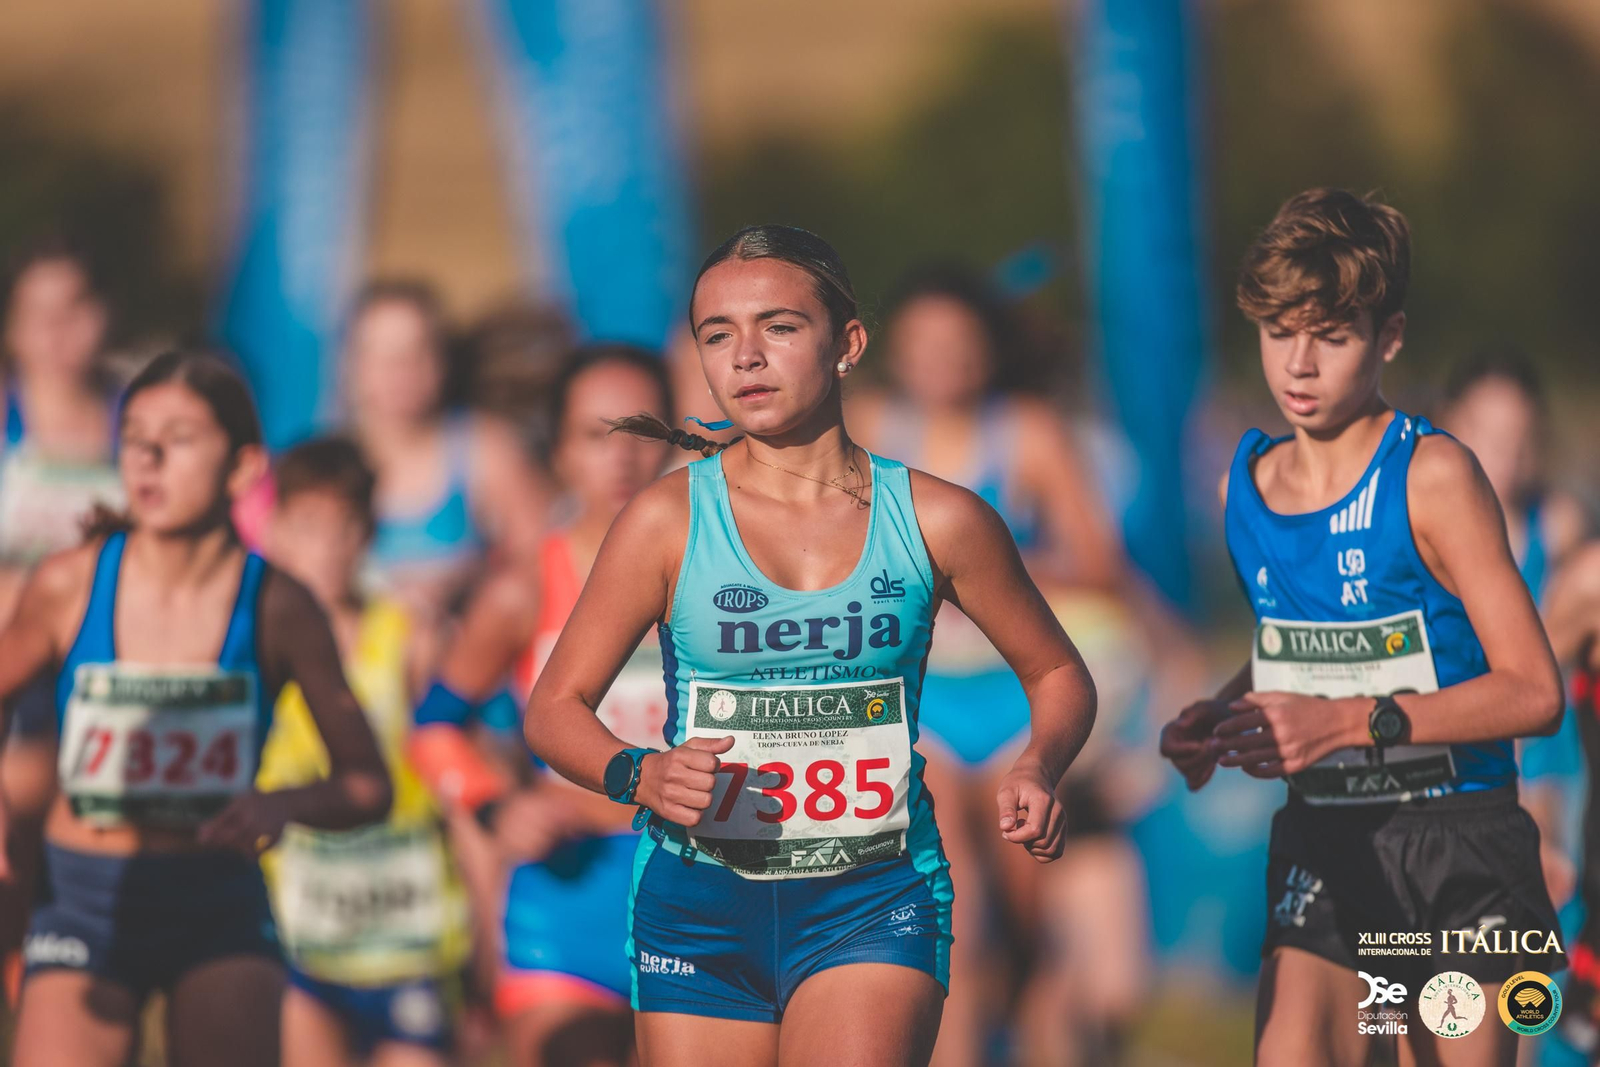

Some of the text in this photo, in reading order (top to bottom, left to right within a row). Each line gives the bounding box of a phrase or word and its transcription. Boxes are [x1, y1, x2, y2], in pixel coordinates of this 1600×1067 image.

[716, 589, 767, 609] TROPS
[717, 601, 903, 661] nerja
[750, 665, 876, 680] ATLETISMO
[750, 692, 853, 718] ITÁLICA
[819, 730, 849, 738] LOPEZ
[85, 726, 240, 786] 7324
[713, 757, 894, 824] 7385
[822, 863, 857, 872] ATLETISMO
